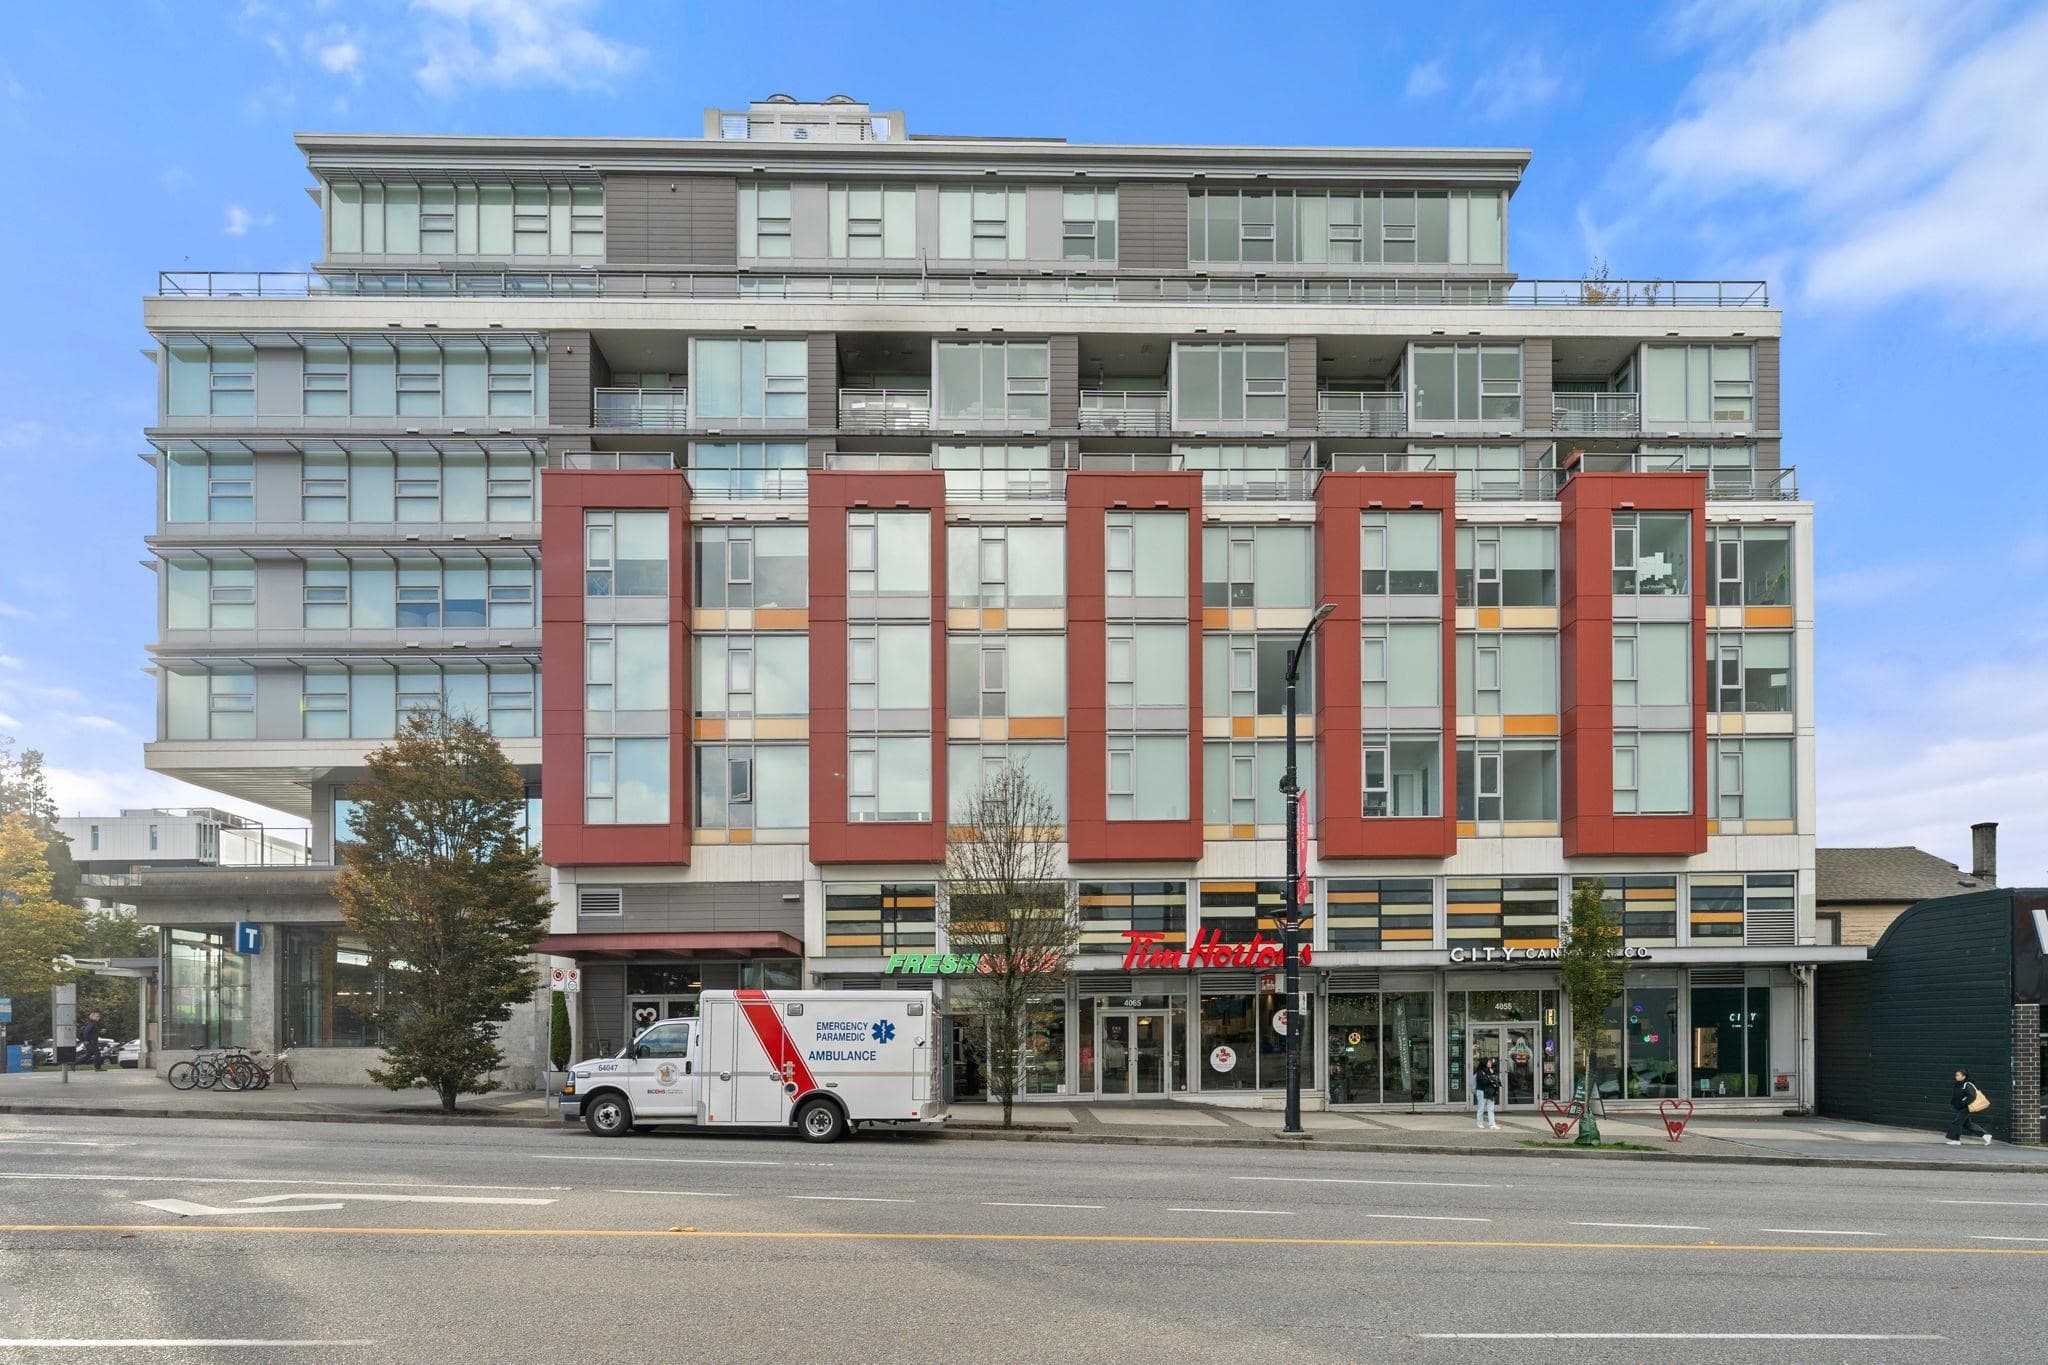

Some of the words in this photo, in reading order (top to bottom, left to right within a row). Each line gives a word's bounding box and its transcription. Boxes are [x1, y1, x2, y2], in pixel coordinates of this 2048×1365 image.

[245, 927, 258, 949] T
[1121, 930, 1183, 970] Tim
[1450, 946, 1516, 962] CITY
[1123, 999, 1142, 1007] 4065
[1729, 1012, 1757, 1022] CIY
[815, 1021, 869, 1031] EMERGENCY
[815, 1032, 866, 1042] PARAMEDIC
[808, 1050, 877, 1061] AMBULANCE
[598, 1064, 618, 1072] 64047
